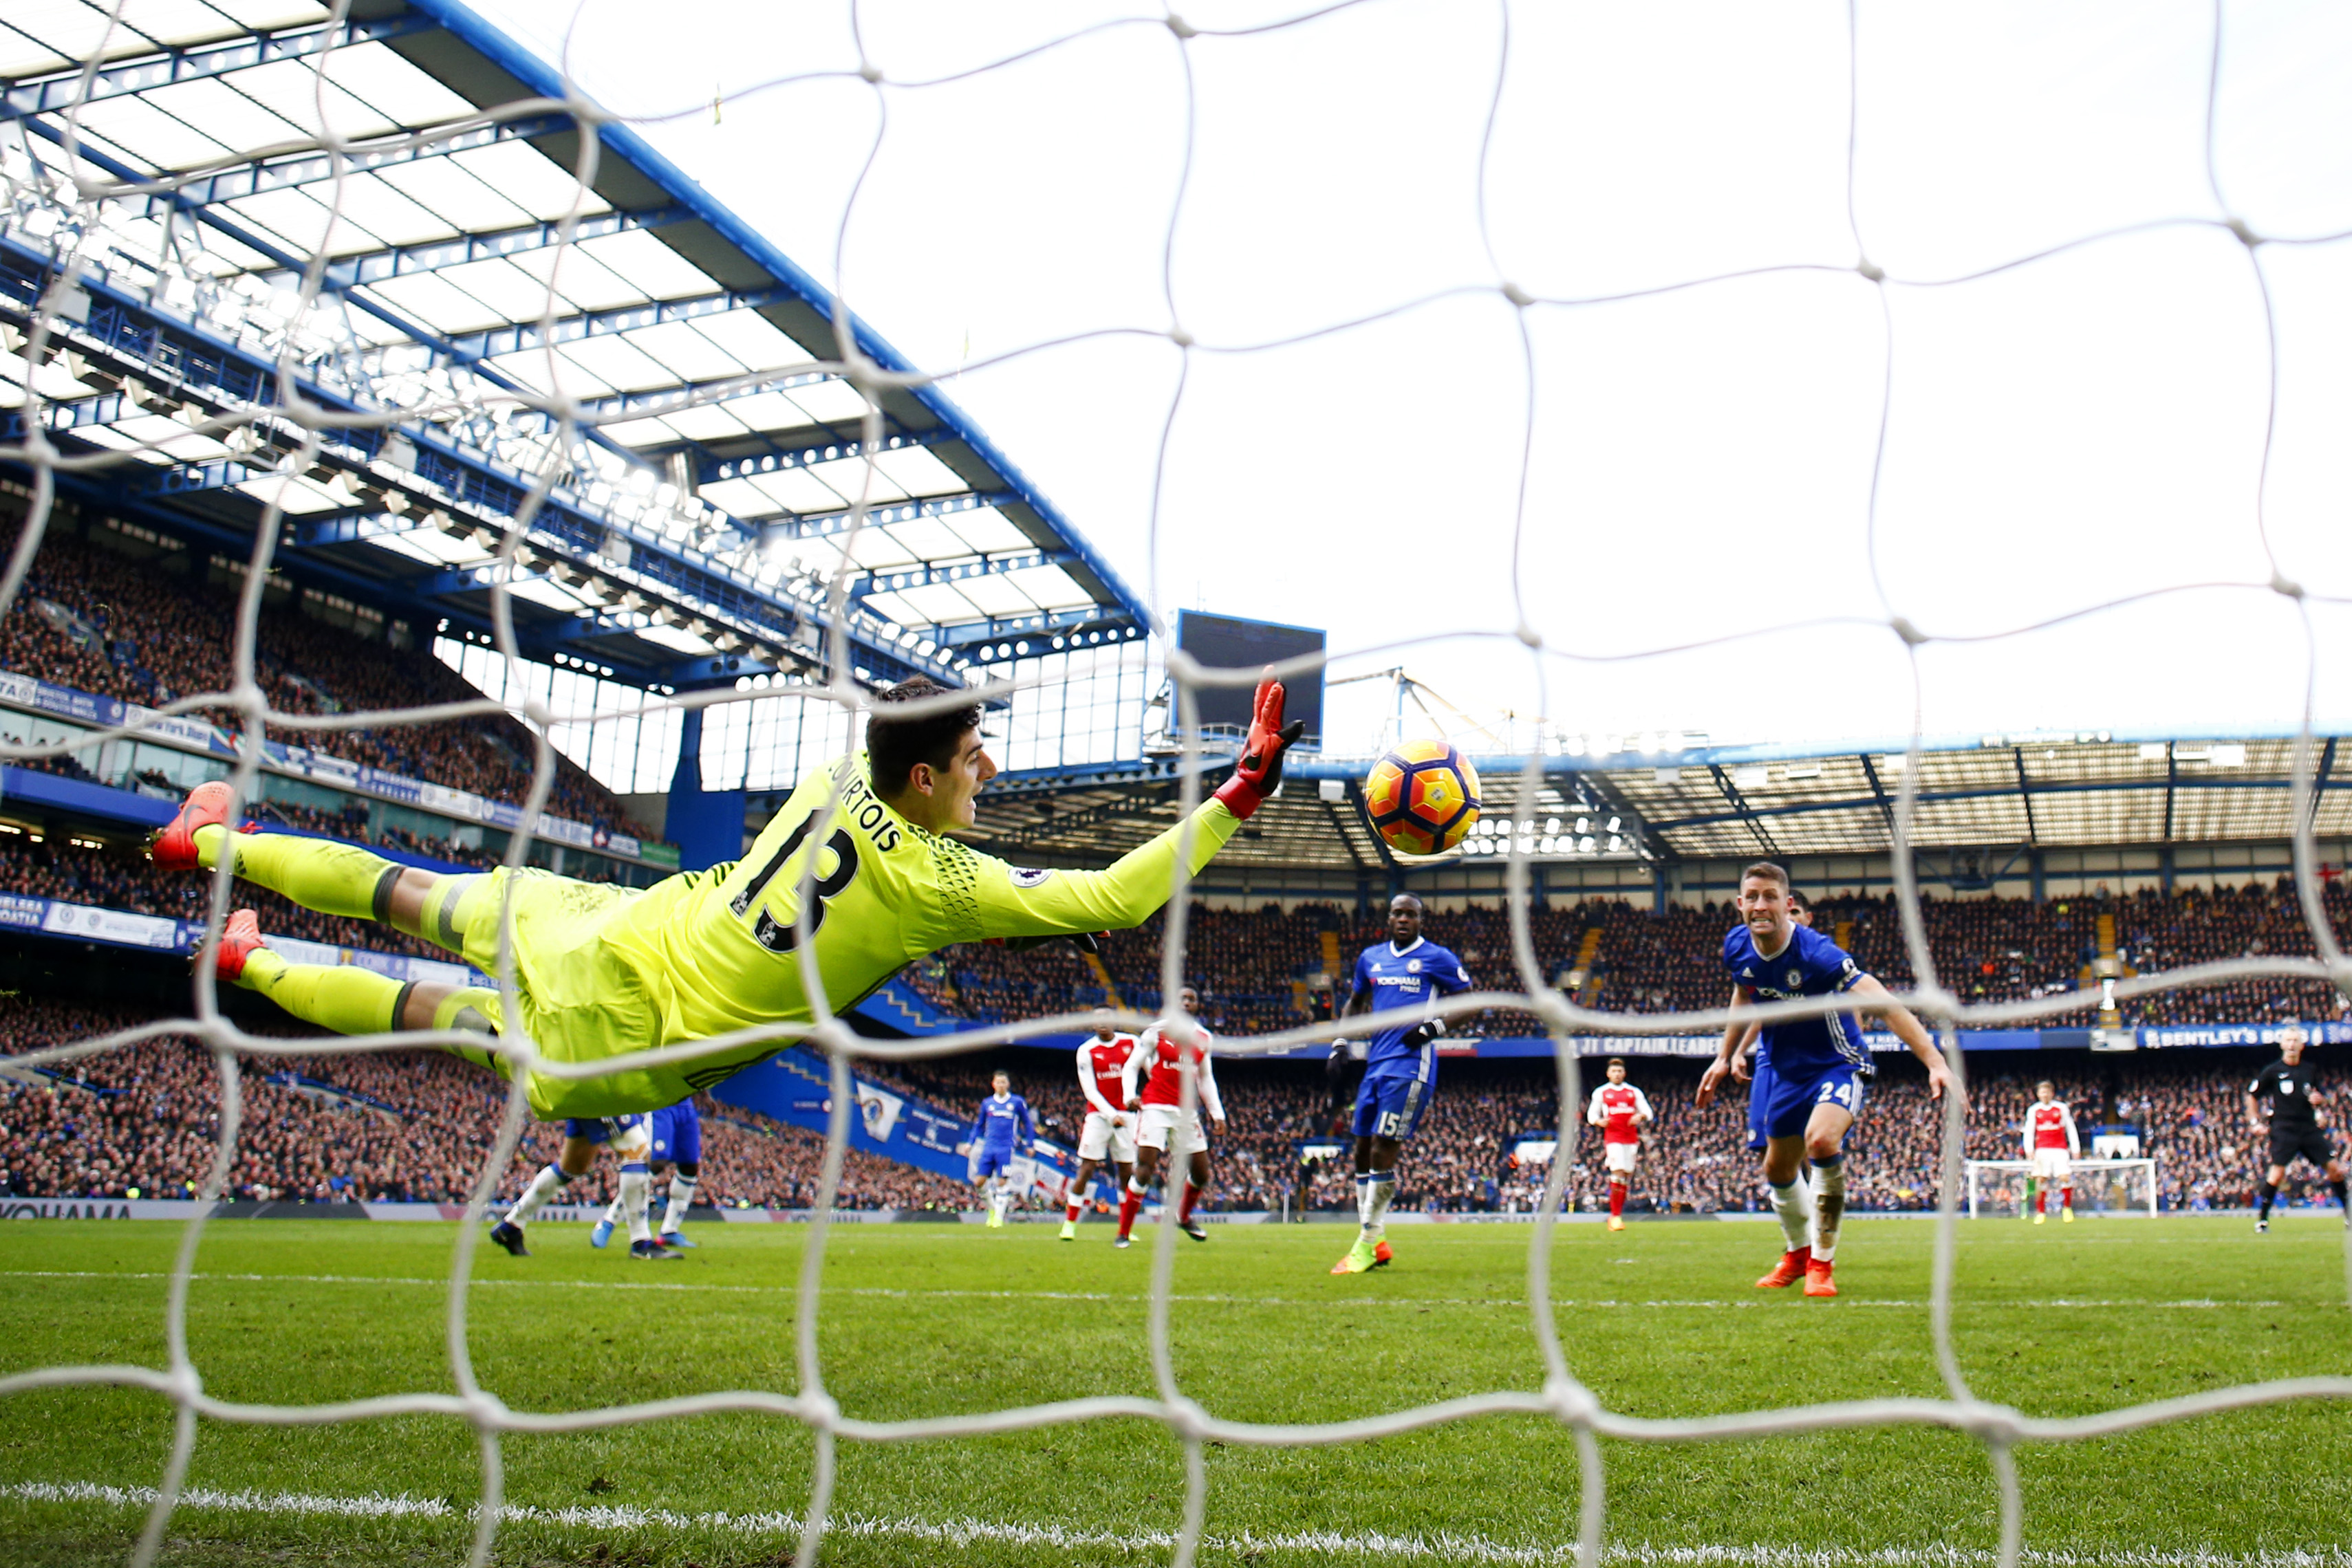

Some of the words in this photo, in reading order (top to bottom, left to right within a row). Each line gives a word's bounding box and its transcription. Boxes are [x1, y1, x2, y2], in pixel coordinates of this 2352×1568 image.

[829, 759, 900, 851] OURTOIS
[729, 807, 860, 953] 13
[1377, 976, 1421, 986] YOKOHAMA
[2160, 1027, 2258, 1047] BENTLEY'S
[1817, 1081, 1851, 1107] 24
[1377, 1111, 1401, 1137] 15
